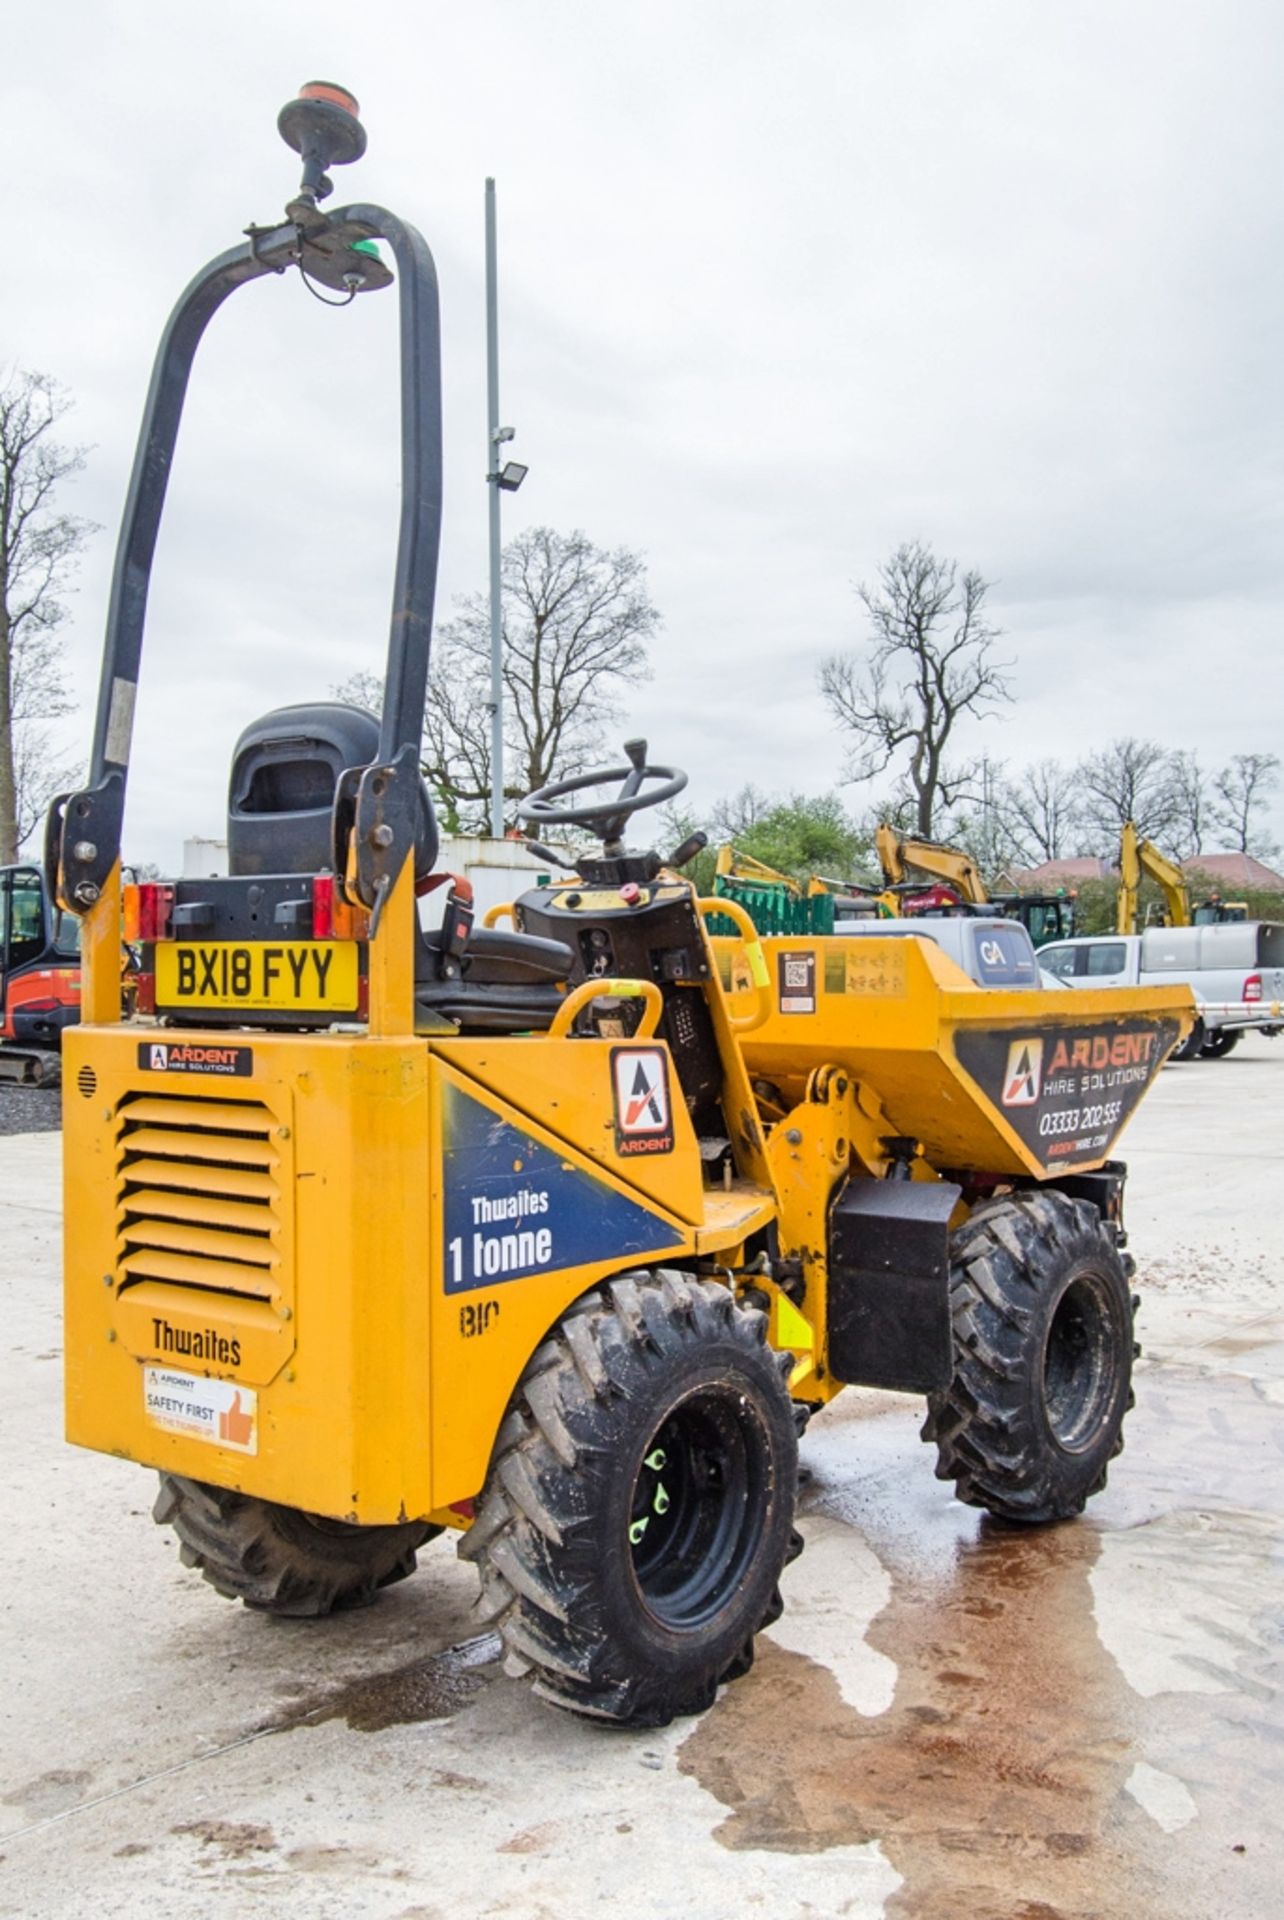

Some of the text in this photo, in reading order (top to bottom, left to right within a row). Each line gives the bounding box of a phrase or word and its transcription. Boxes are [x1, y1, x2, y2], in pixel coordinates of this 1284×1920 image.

[177, 949, 333, 998] BX18 FYY
[168, 1062, 236, 1073] HIRE SOLUTIONS
[170, 1047, 239, 1064] ARDENT
[1047, 1031, 1157, 1075] ARDENT
[1043, 1066, 1149, 1097] HIRE SOLUTIONS
[1039, 1110, 1081, 1136] 03333
[1080, 1103, 1104, 1130] 202
[620, 1137, 671, 1153] ARDENT
[471, 1190, 549, 1225] Thwaites
[449, 1228, 552, 1283] 1 tonne
[152, 1318, 241, 1366] Thwaites
[147, 1394, 215, 1421] SAFETY FIRST
